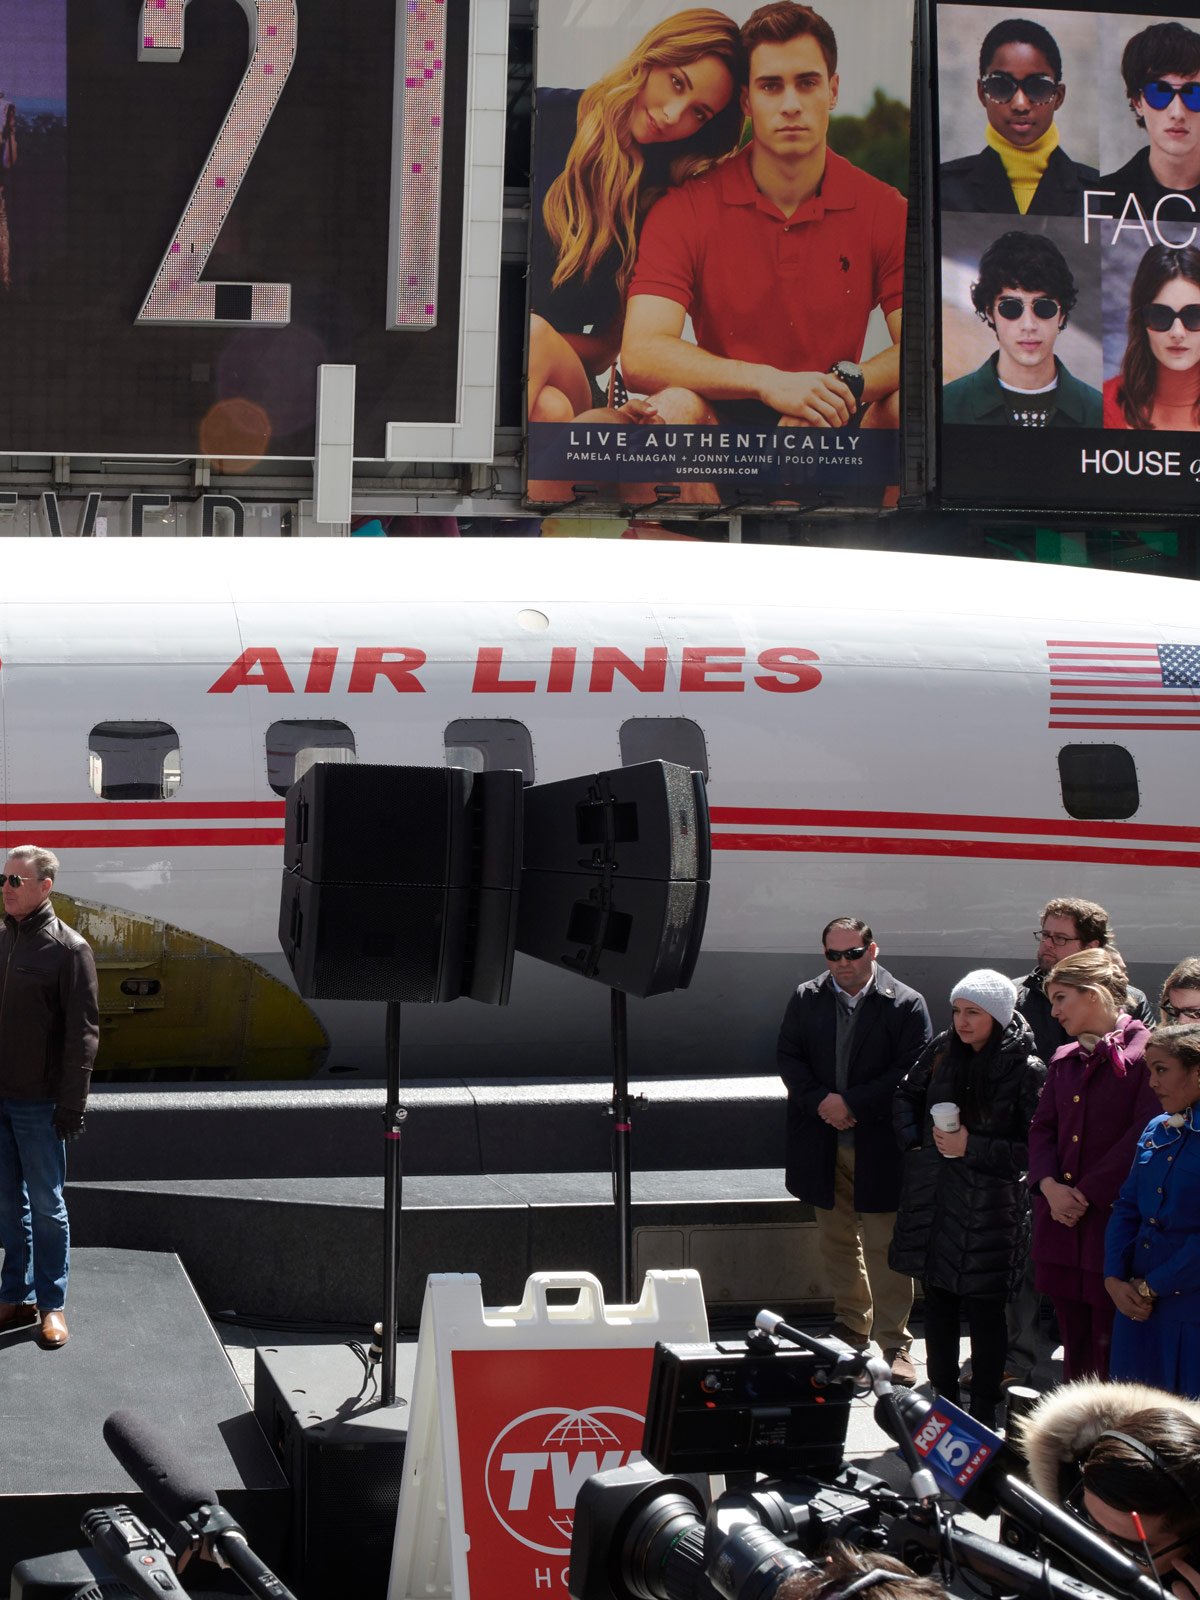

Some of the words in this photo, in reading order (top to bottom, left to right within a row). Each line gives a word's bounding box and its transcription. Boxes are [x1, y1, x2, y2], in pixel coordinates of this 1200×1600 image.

[569, 430, 628, 447] LIVE
[645, 432, 861, 451] AUTHENTICALLY
[566, 451, 612, 462] PAMELA
[615, 453, 677, 463] FLANAGAN
[692, 454, 731, 464] JONNY
[734, 454, 774, 464] LAVINE
[784, 455, 814, 465] POLO
[818, 456, 864, 466] PLAYERS
[675, 466, 759, 476] USPOLOASSN.COM
[1081, 449, 1181, 477] HOUSE
[209, 647, 426, 693] AIR
[472, 648, 822, 693] LINES
[914, 1415, 947, 1452] FOX
[935, 1431, 971, 1467] 5
[959, 1447, 988, 1483] NEWS
